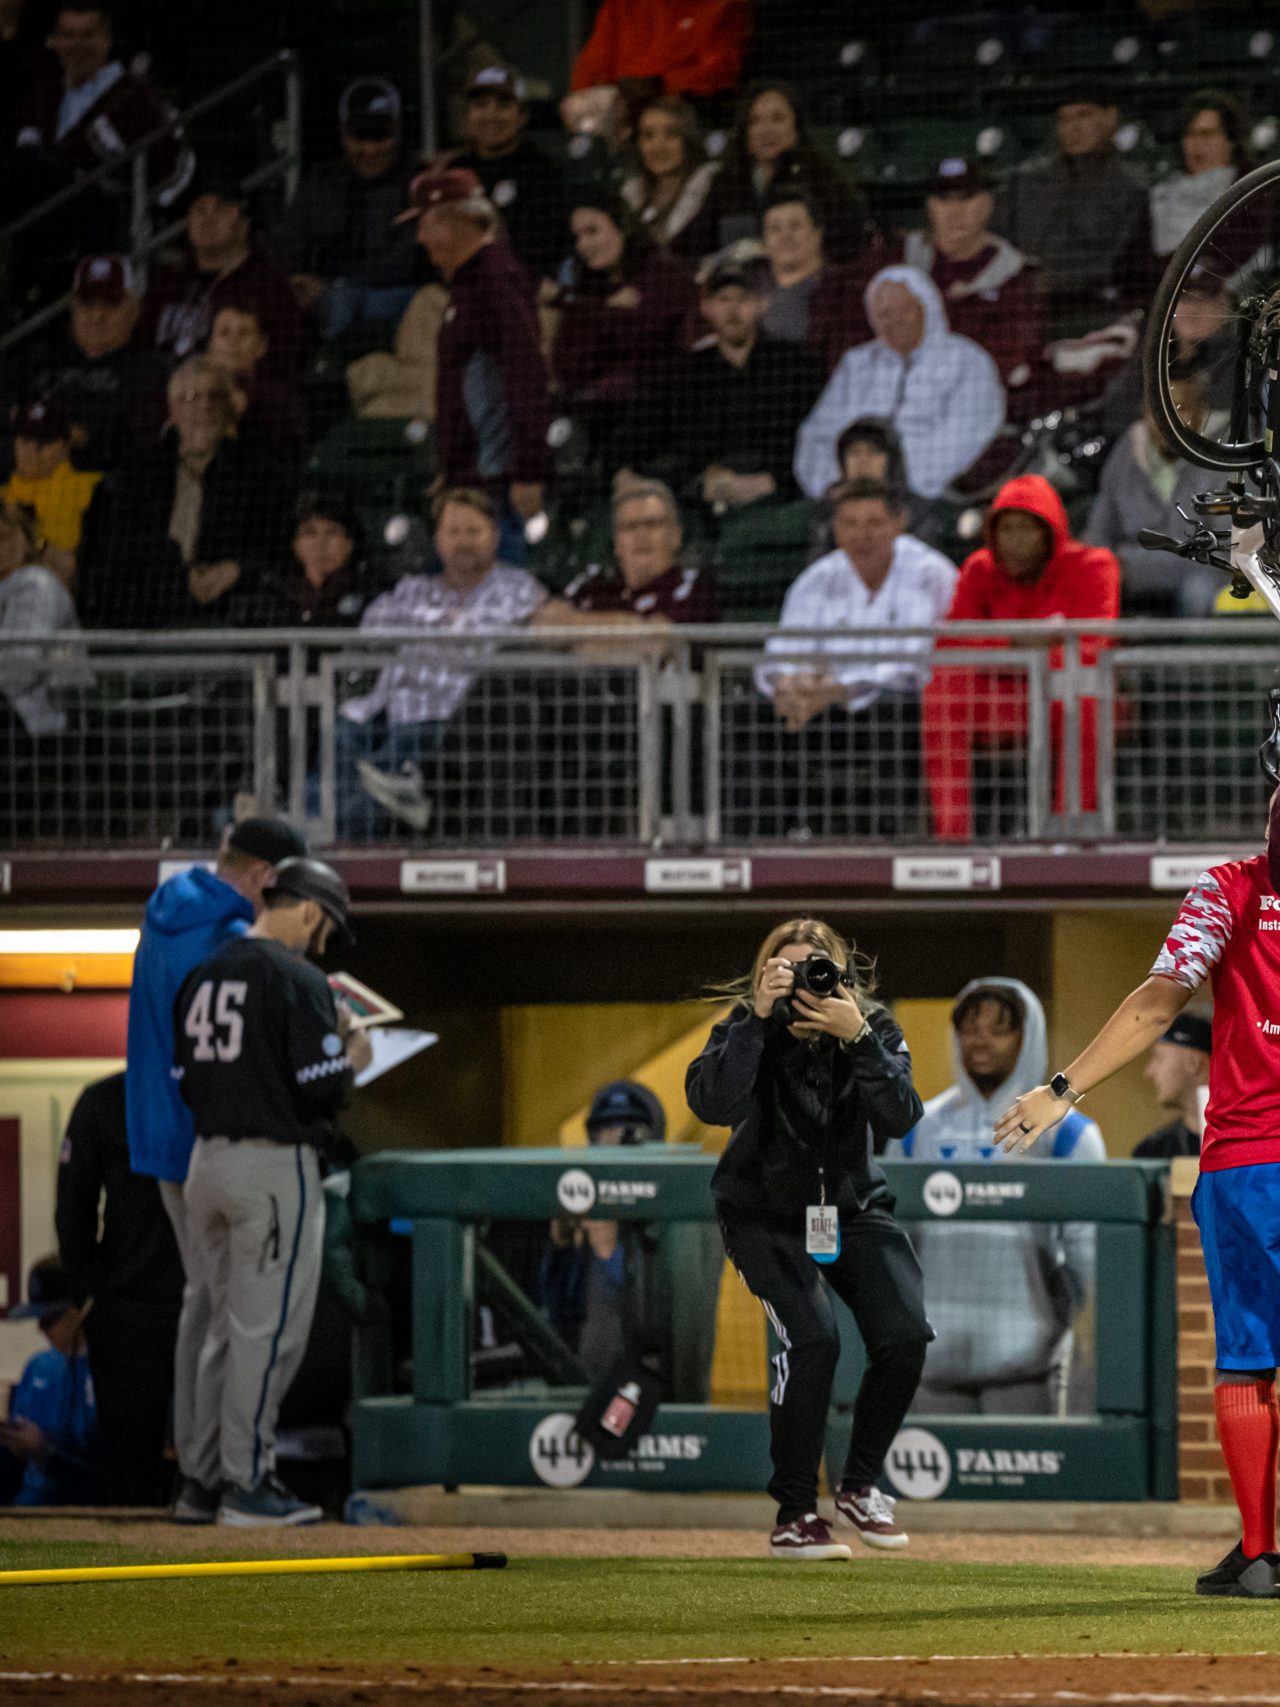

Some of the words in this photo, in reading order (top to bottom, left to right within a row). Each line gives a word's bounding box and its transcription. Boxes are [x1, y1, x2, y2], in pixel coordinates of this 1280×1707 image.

[184, 979, 248, 1063] 45
[537, 1436, 587, 1468] 44
[628, 1433, 702, 1459] RMS
[892, 1450, 943, 1481] 44
[957, 1450, 1060, 1474] FARMS
